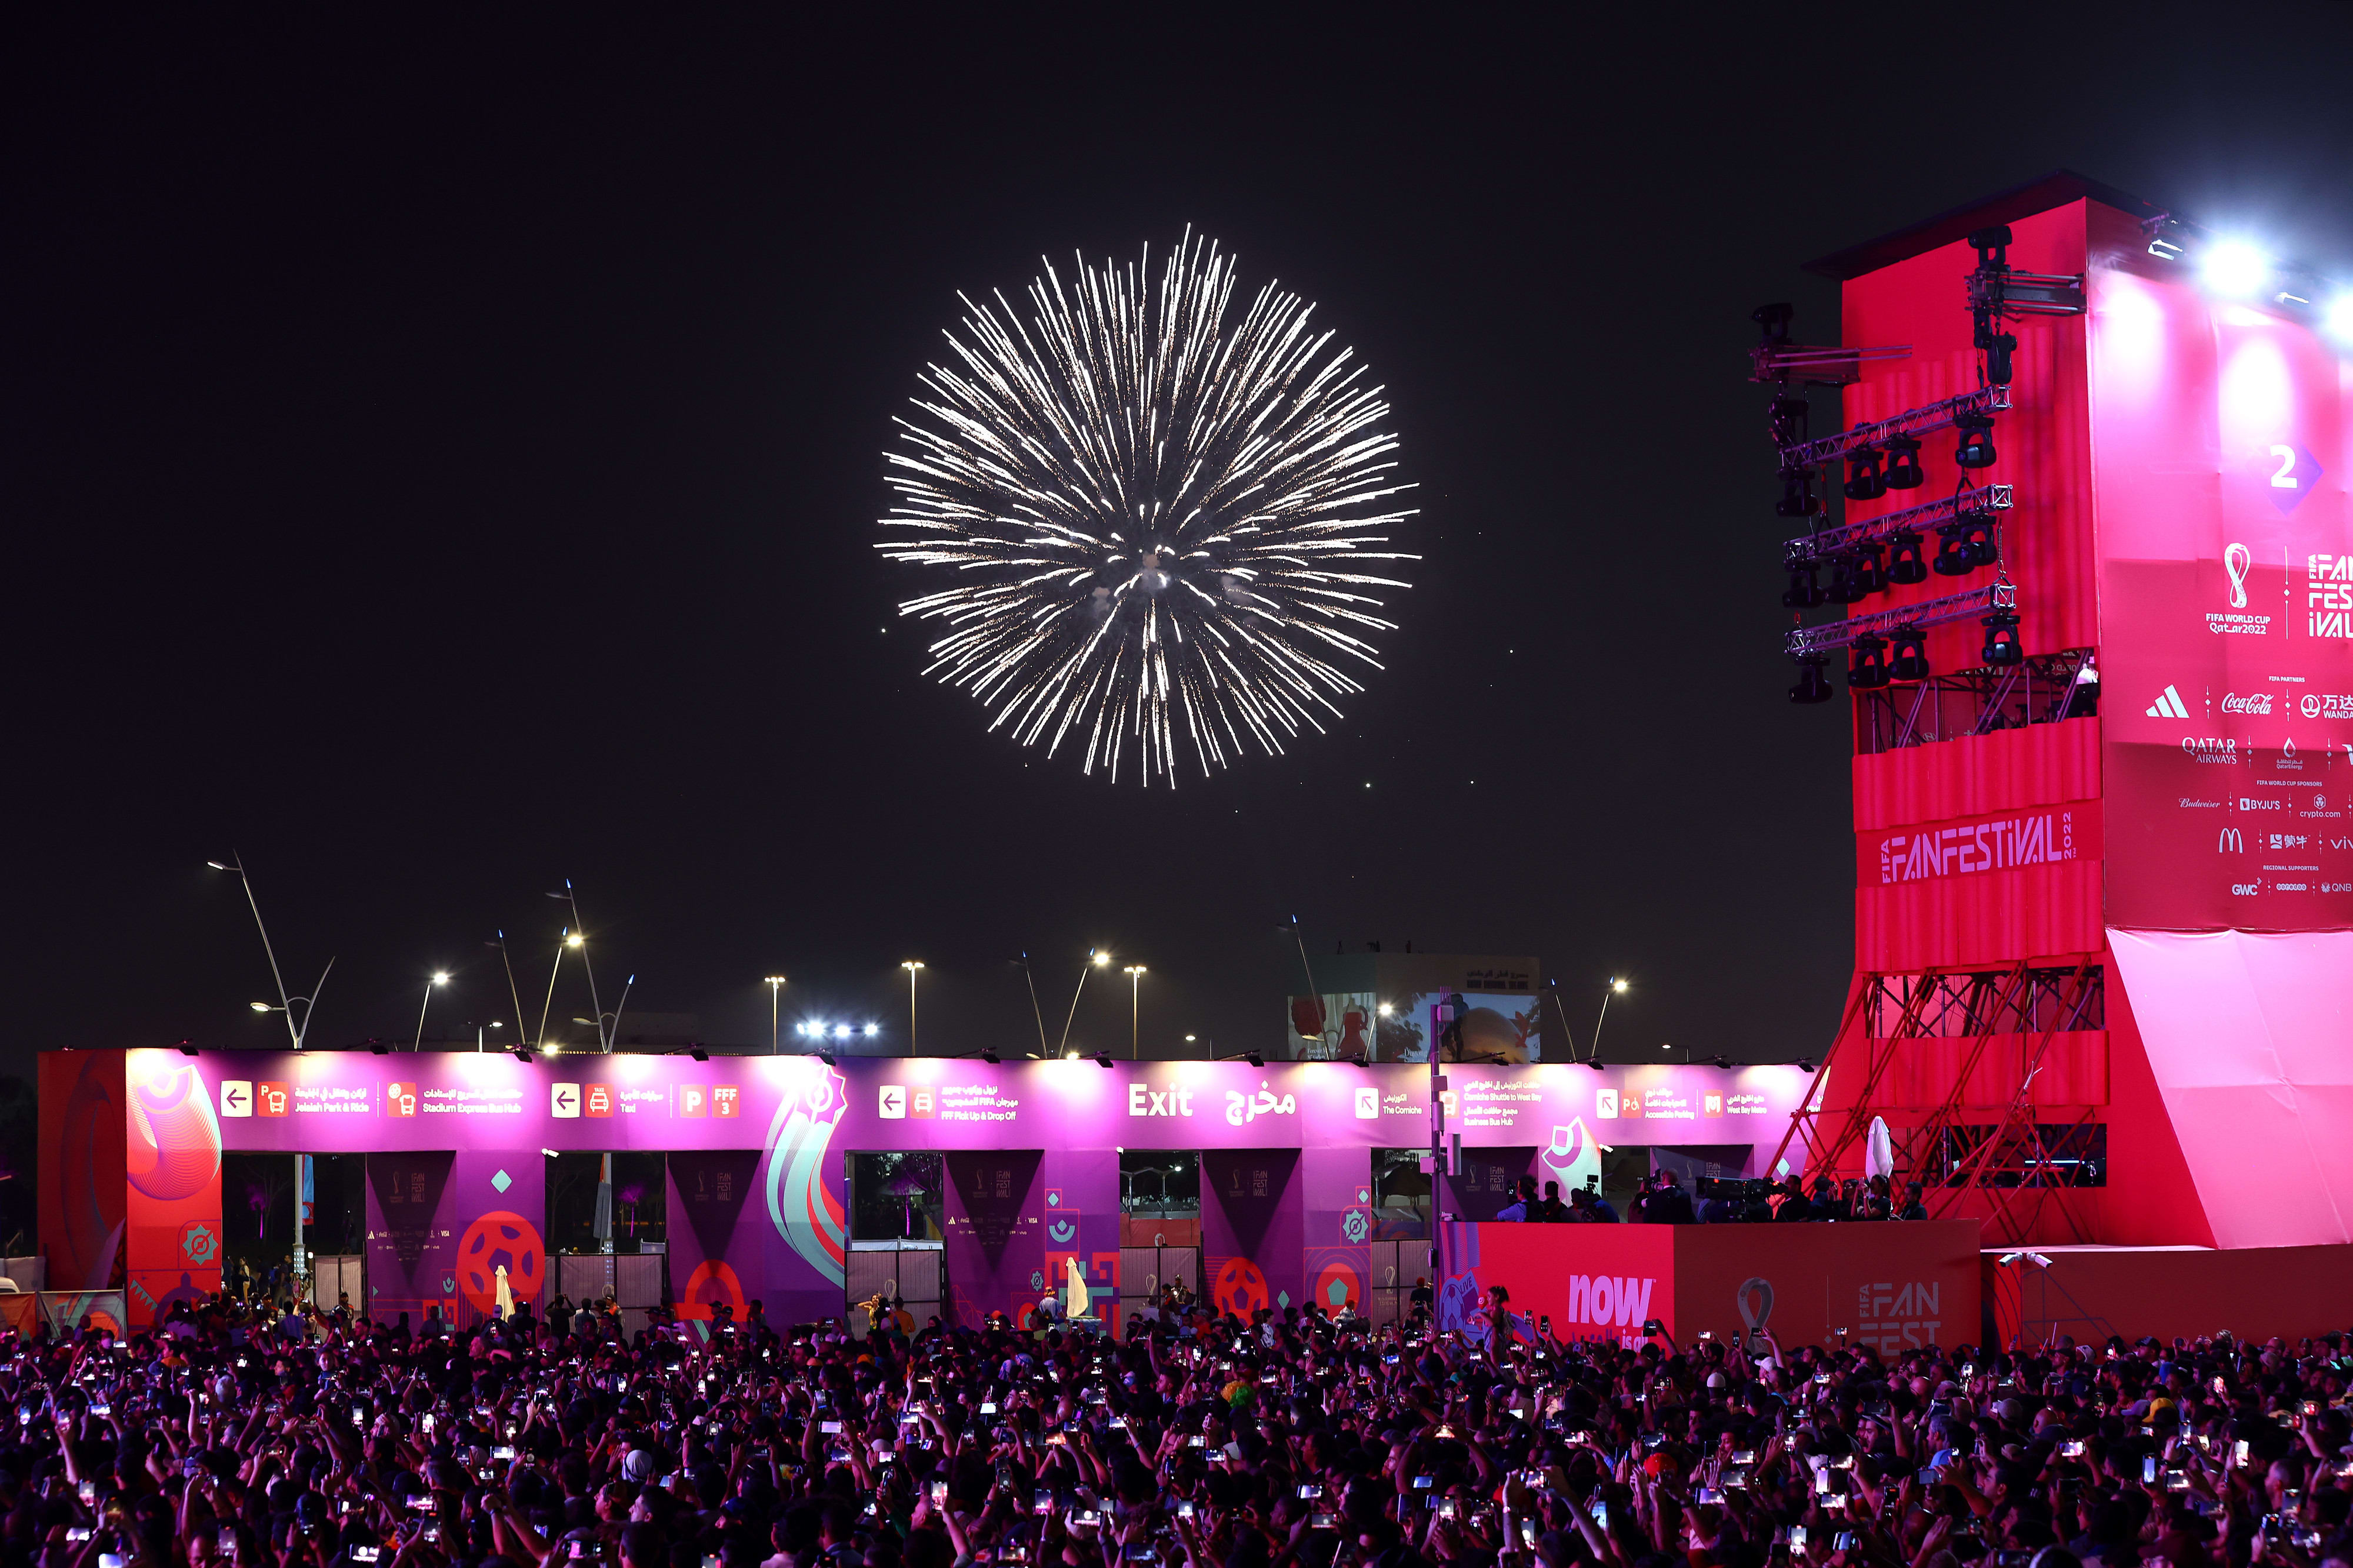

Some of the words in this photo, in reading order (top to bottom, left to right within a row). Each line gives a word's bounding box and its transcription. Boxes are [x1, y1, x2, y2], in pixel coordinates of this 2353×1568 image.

[2270, 445, 2298, 488] 2
[2308, 554, 2317, 579] FIFA
[2308, 582, 2353, 609] FES
[2206, 613, 2224, 622] FIFA
[2225, 614, 2254, 623] WORLD
[2255, 615, 2271, 624] CUP
[2322, 694, 2353, 710] 万达
[2323, 710, 2353, 719] WANDA
[2182, 736, 2237, 756] QATAR
[2196, 754, 2237, 764] AIRWAYS
[2179, 798, 2221, 808] Budweiser
[2251, 799, 2281, 810] BYJU'S
[2299, 810, 2341, 819] crypto.com
[1881, 838, 1891, 883] FIFA
[2063, 812, 2072, 859] 2022
[2232, 883, 2258, 896] GWC
[2331, 883, 2352, 892] QNB
[261, 1085, 269, 1096] P
[715, 1088, 737, 1100] FFF
[687, 1091, 701, 1112] P
[979, 1097, 995, 1106] FIFA
[1129, 1082, 1194, 1117] Exit
[1225, 1080, 1297, 1126] مخرج
[1384, 1093, 1407, 1103] الكورنيش
[1464, 1093, 1489, 1101] Corniche
[1489, 1093, 1510, 1101] Shuttle
[1531, 1093, 1542, 1102] Bay
[324, 1102, 342, 1112] Park
[342, 1103, 349, 1112] &
[351, 1102, 369, 1112] Ride
[422, 1103, 456, 1113] Stadium
[457, 1103, 488, 1114] Express
[488, 1103, 503, 1113] Bus
[504, 1103, 521, 1113] Hub
[620, 1103, 636, 1113] Taxi
[721, 1102, 730, 1115] 3
[1623, 1099, 1630, 1110] P
[1383, 1106, 1394, 1115] The
[1395, 1106, 1422, 1115] Corniche
[1645, 1110, 1674, 1119] Accessible
[1674, 1110, 1695, 1120] Parking
[1727, 1106, 1740, 1114] West
[1741, 1106, 1751, 1115] Bay
[1751, 1106, 1767, 1114] Metro
[954, 1111, 969, 1120] Pick
[970, 1112, 981, 1122] Up
[981, 1112, 987, 1120] &
[987, 1112, 1005, 1122] Drop
[1006, 1111, 1016, 1120] Off
[1464, 1117, 1489, 1126] Business
[1501, 1117, 1514, 1126] Hub
[1459, 1276, 1472, 1294] LIVE
[1568, 1274, 1653, 1327] now
[1859, 1284, 1870, 1318] FIFA
[1873, 1282, 1939, 1318] FAN
[1622, 1329, 1632, 1350] is
